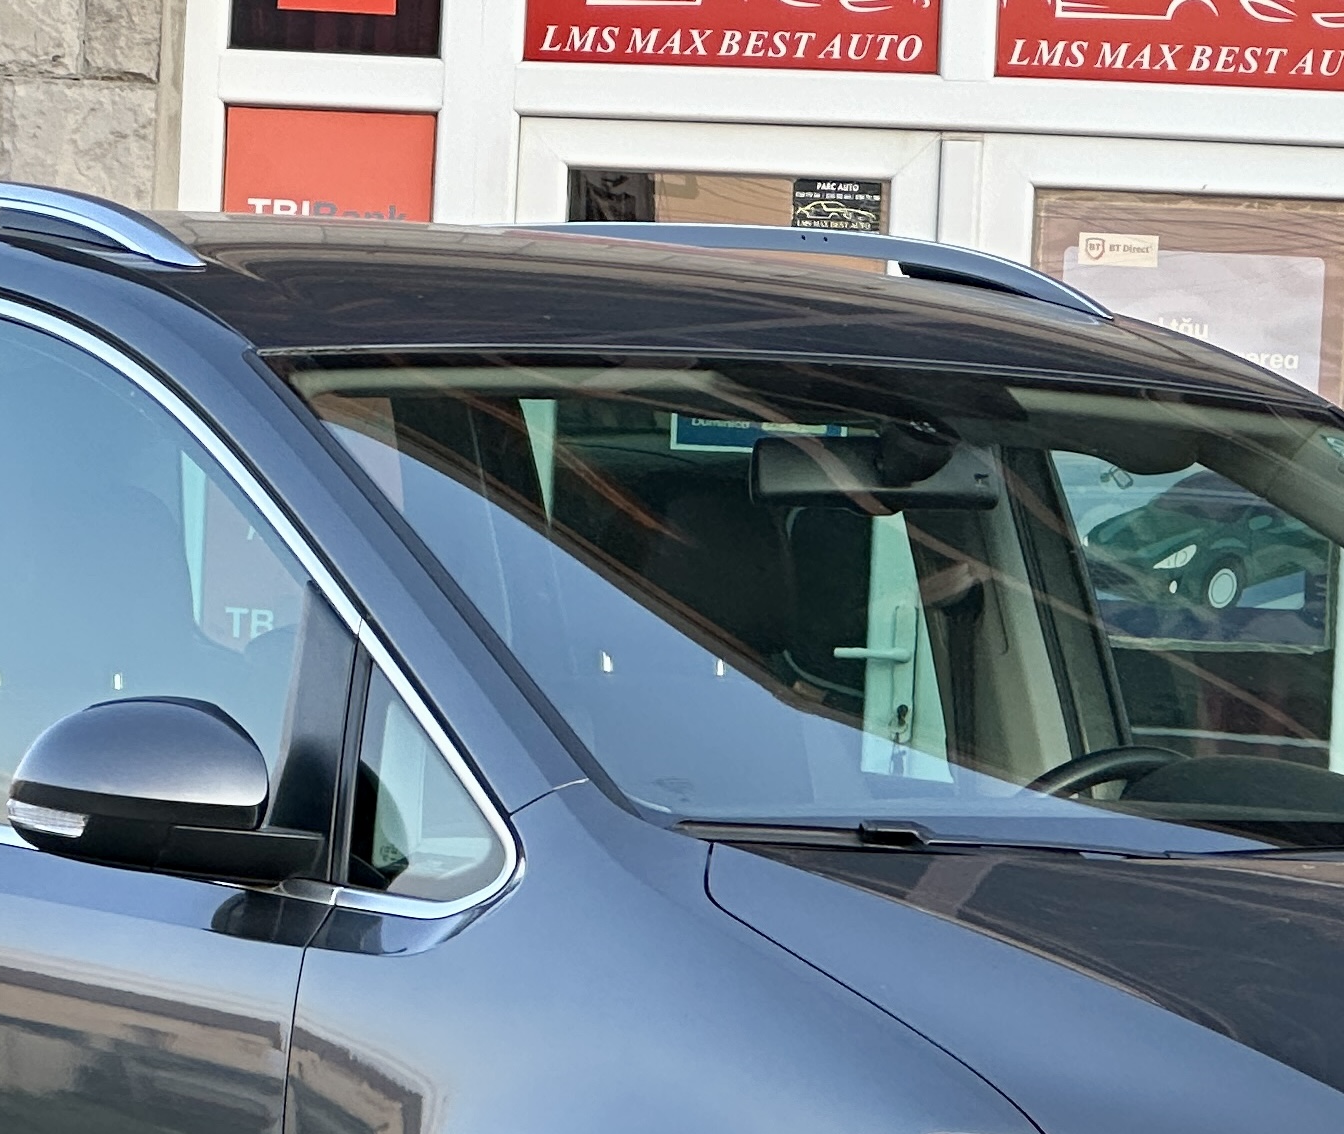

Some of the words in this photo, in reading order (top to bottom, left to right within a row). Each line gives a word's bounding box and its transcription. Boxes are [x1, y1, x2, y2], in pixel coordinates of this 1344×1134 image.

[539, 24, 621, 53] LMS
[625, 27, 714, 56] MAX
[716, 30, 817, 58] BEST
[817, 32, 924, 62] AUTO
[1007, 38, 1089, 68] LMS
[1094, 41, 1184, 70] MAX
[1187, 44, 1288, 74] BEST
[1109, 243, 1122, 253] BT
[1123, 244, 1151, 254] Direct
